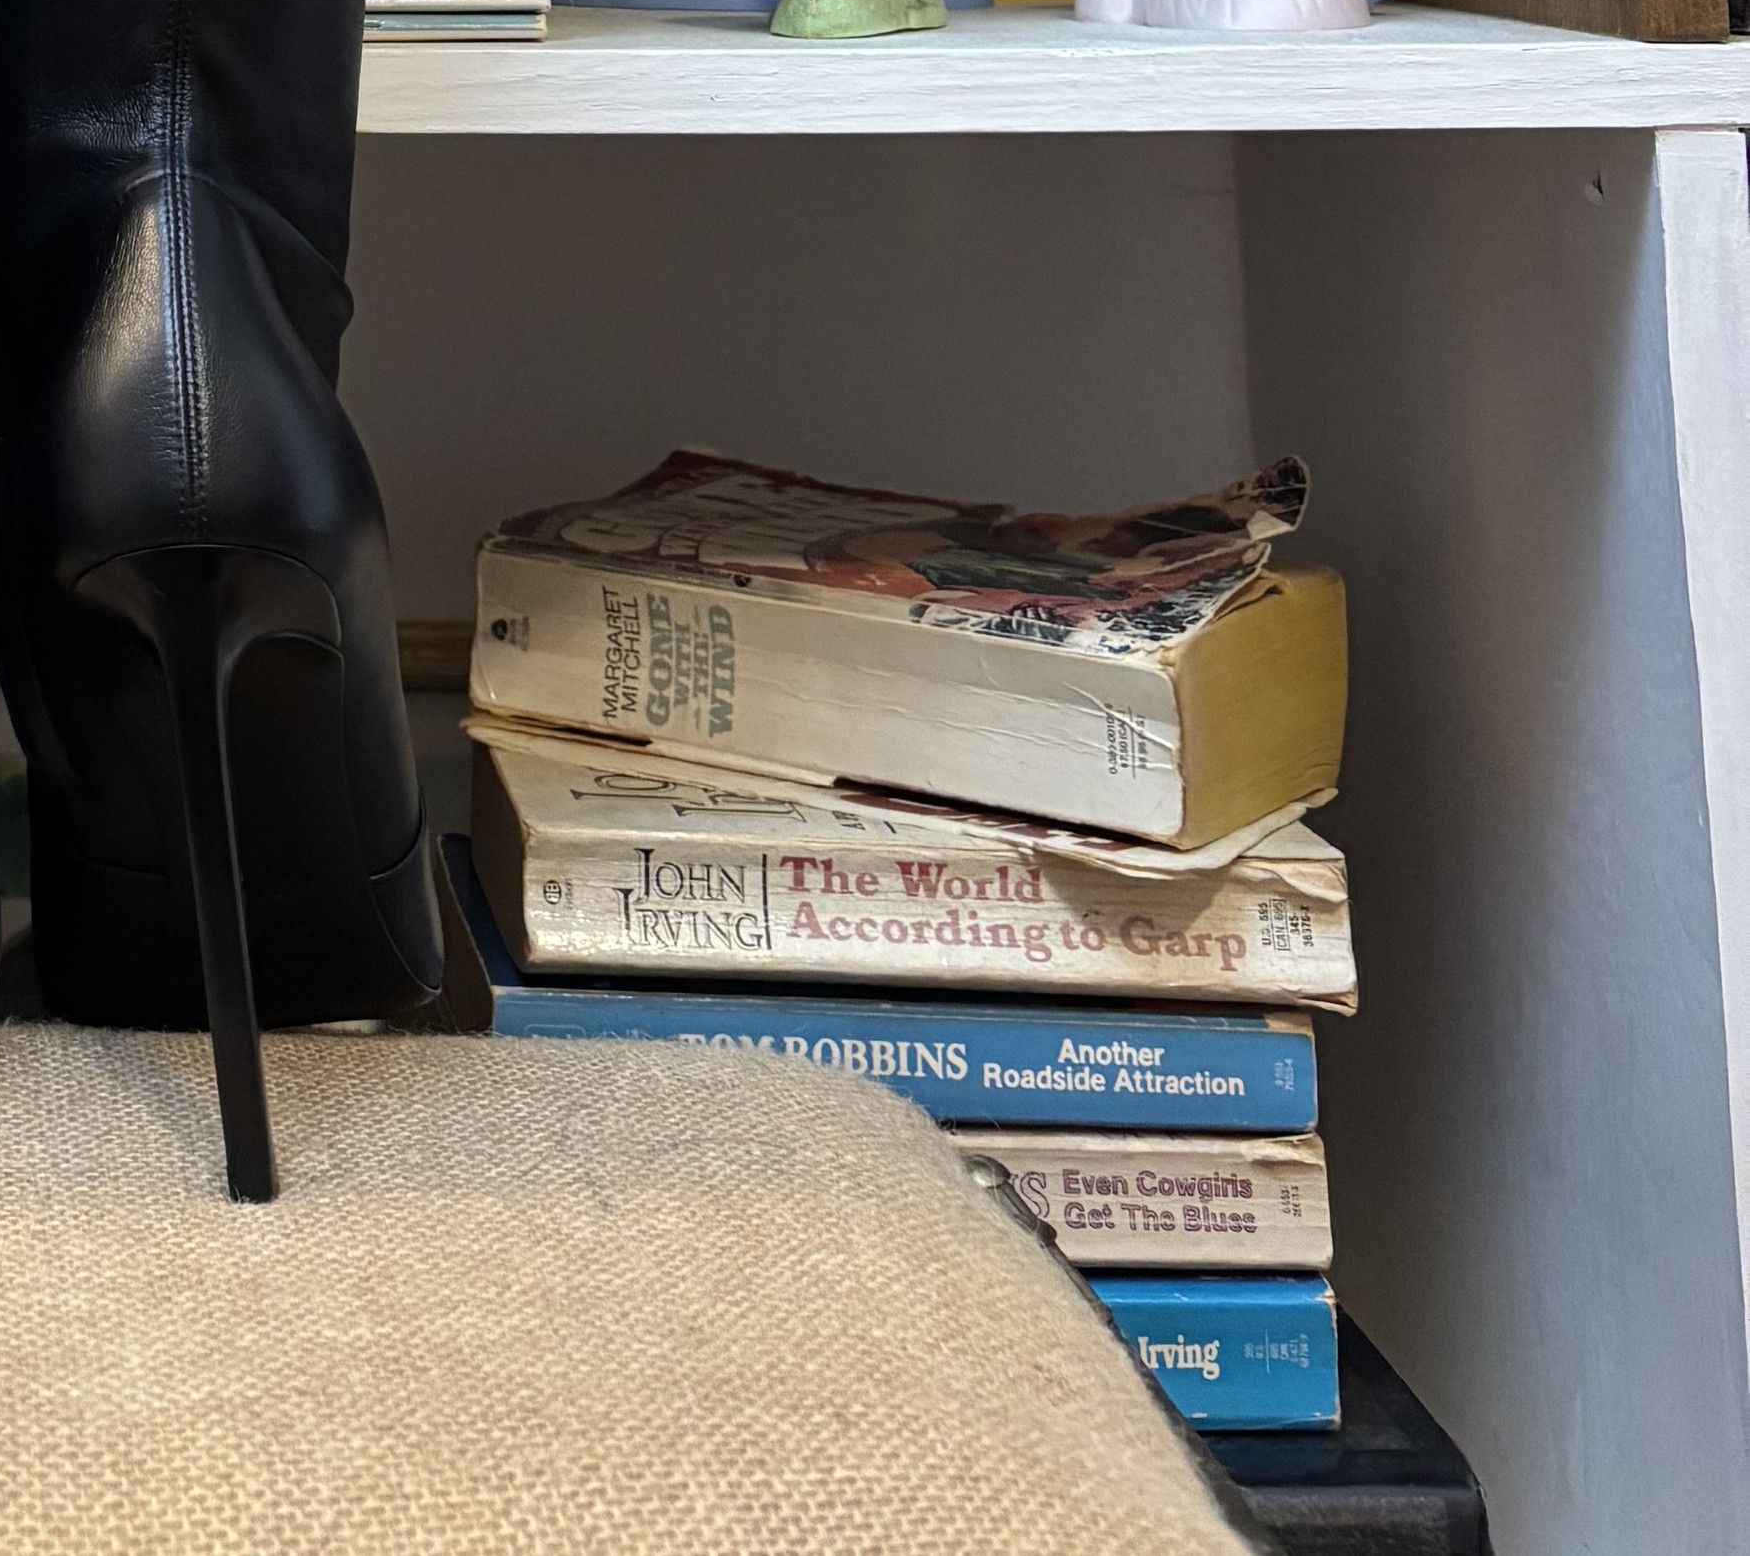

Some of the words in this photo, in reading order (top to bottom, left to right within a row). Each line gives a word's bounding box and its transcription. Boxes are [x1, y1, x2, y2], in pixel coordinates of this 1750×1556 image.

[602, 585, 622, 719] MARGARET
[621, 595, 640, 713] MITCHELL
[780, 855, 880, 898] The
[897, 859, 1045, 904] World
[786, 901, 1052, 963] According
[1061, 915, 1104, 952] to
[1120, 911, 1247, 972] Garp
[1057, 1039, 1165, 1067] Another
[983, 1062, 1106, 1092] Roadside
[1112, 1067, 1245, 1098] Attraction
[1063, 1168, 1129, 1196] Even
[1135, 1169, 1253, 1203] Cowgirls
[1064, 1201, 1116, 1230] Get
[1126, 1203, 1177, 1232] The
[1182, 1205, 1259, 1234] Blues
